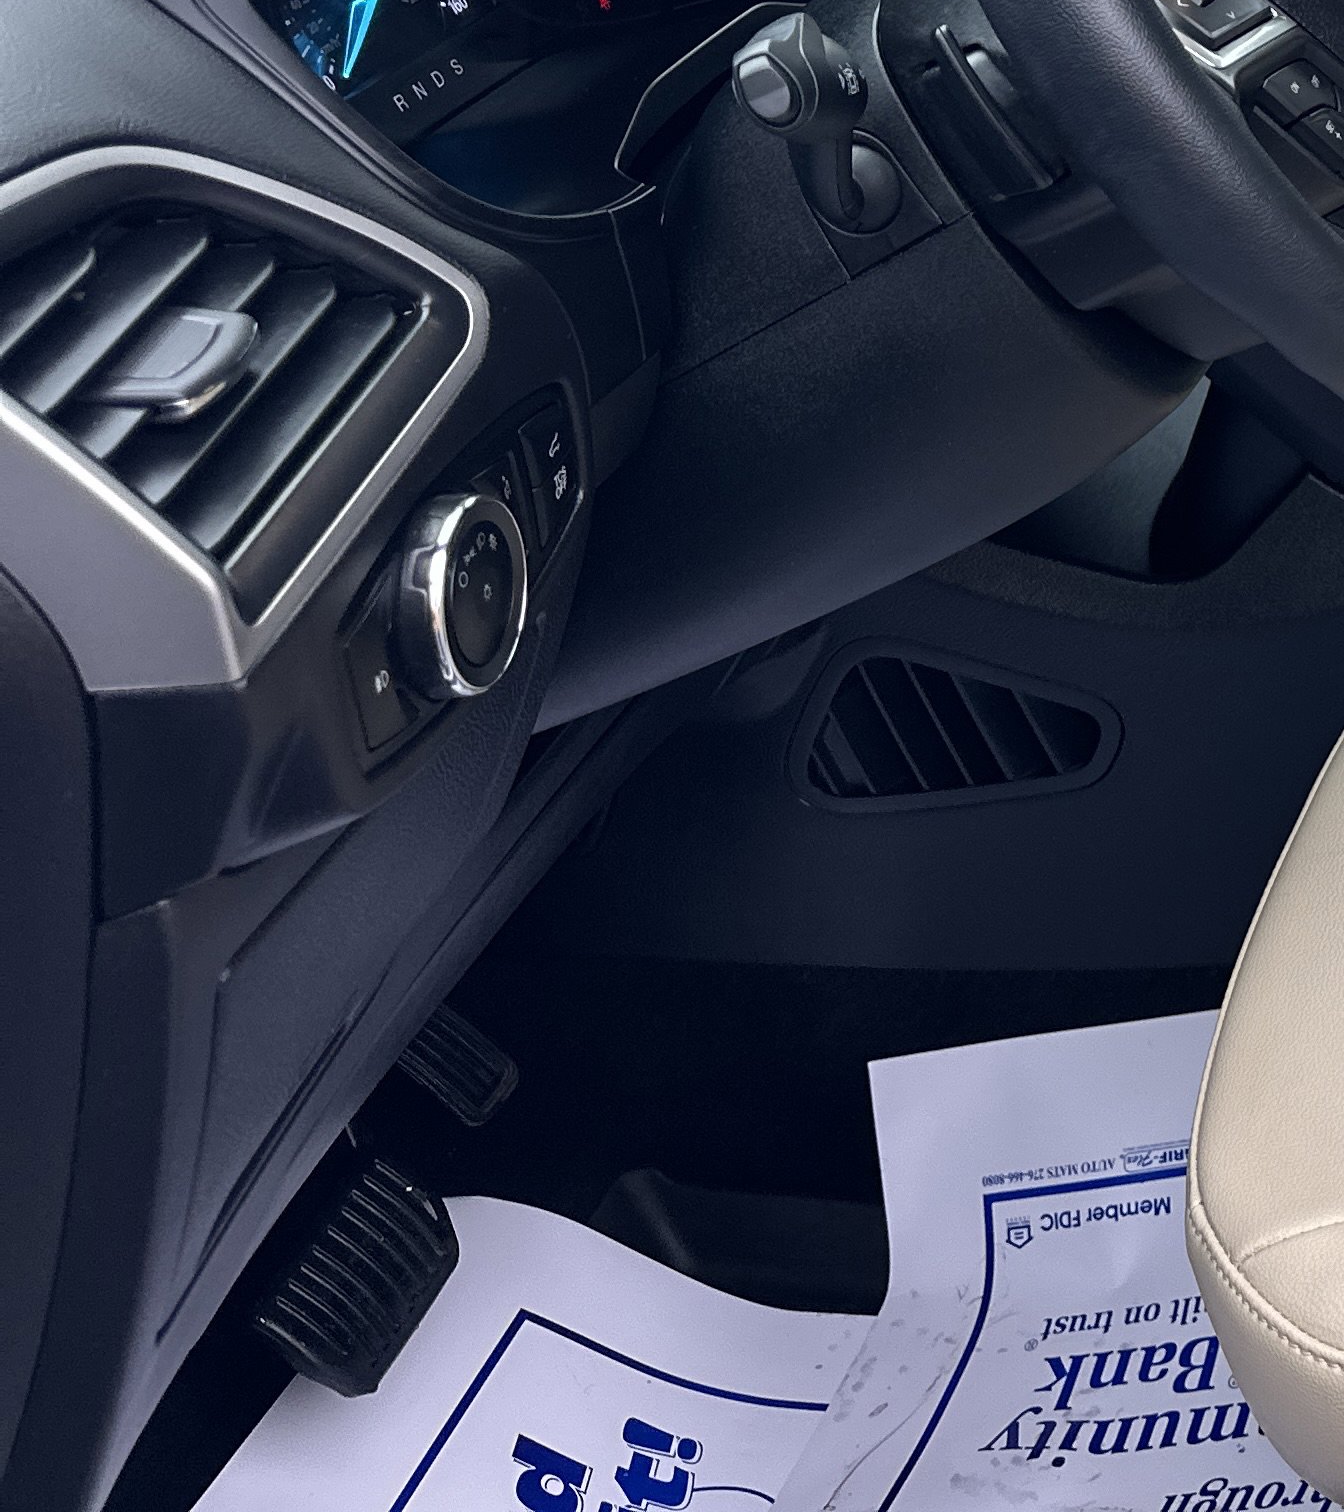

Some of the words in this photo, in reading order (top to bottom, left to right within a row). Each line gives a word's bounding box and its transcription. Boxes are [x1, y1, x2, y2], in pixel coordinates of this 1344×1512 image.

[322, 75, 336, 92] 0
[393, 94, 409, 112] R
[412, 81, 428, 100] N
[430, 70, 445, 88] D
[450, 58, 464, 75] S
[1047, 1163, 1079, 1179] MATS
[1081, 1158, 1116, 1175] AUTO
[1040, 1209, 1081, 1232] FDIC
[1086, 1196, 1171, 1222] Member
[1124, 1302, 1160, 1326] on
[1170, 1296, 1207, 1326] ilt
[1040, 1310, 1113, 1341] trust
[1034, 1335, 1219, 1410] Bank
[978, 1402, 1262, 1468] munity
